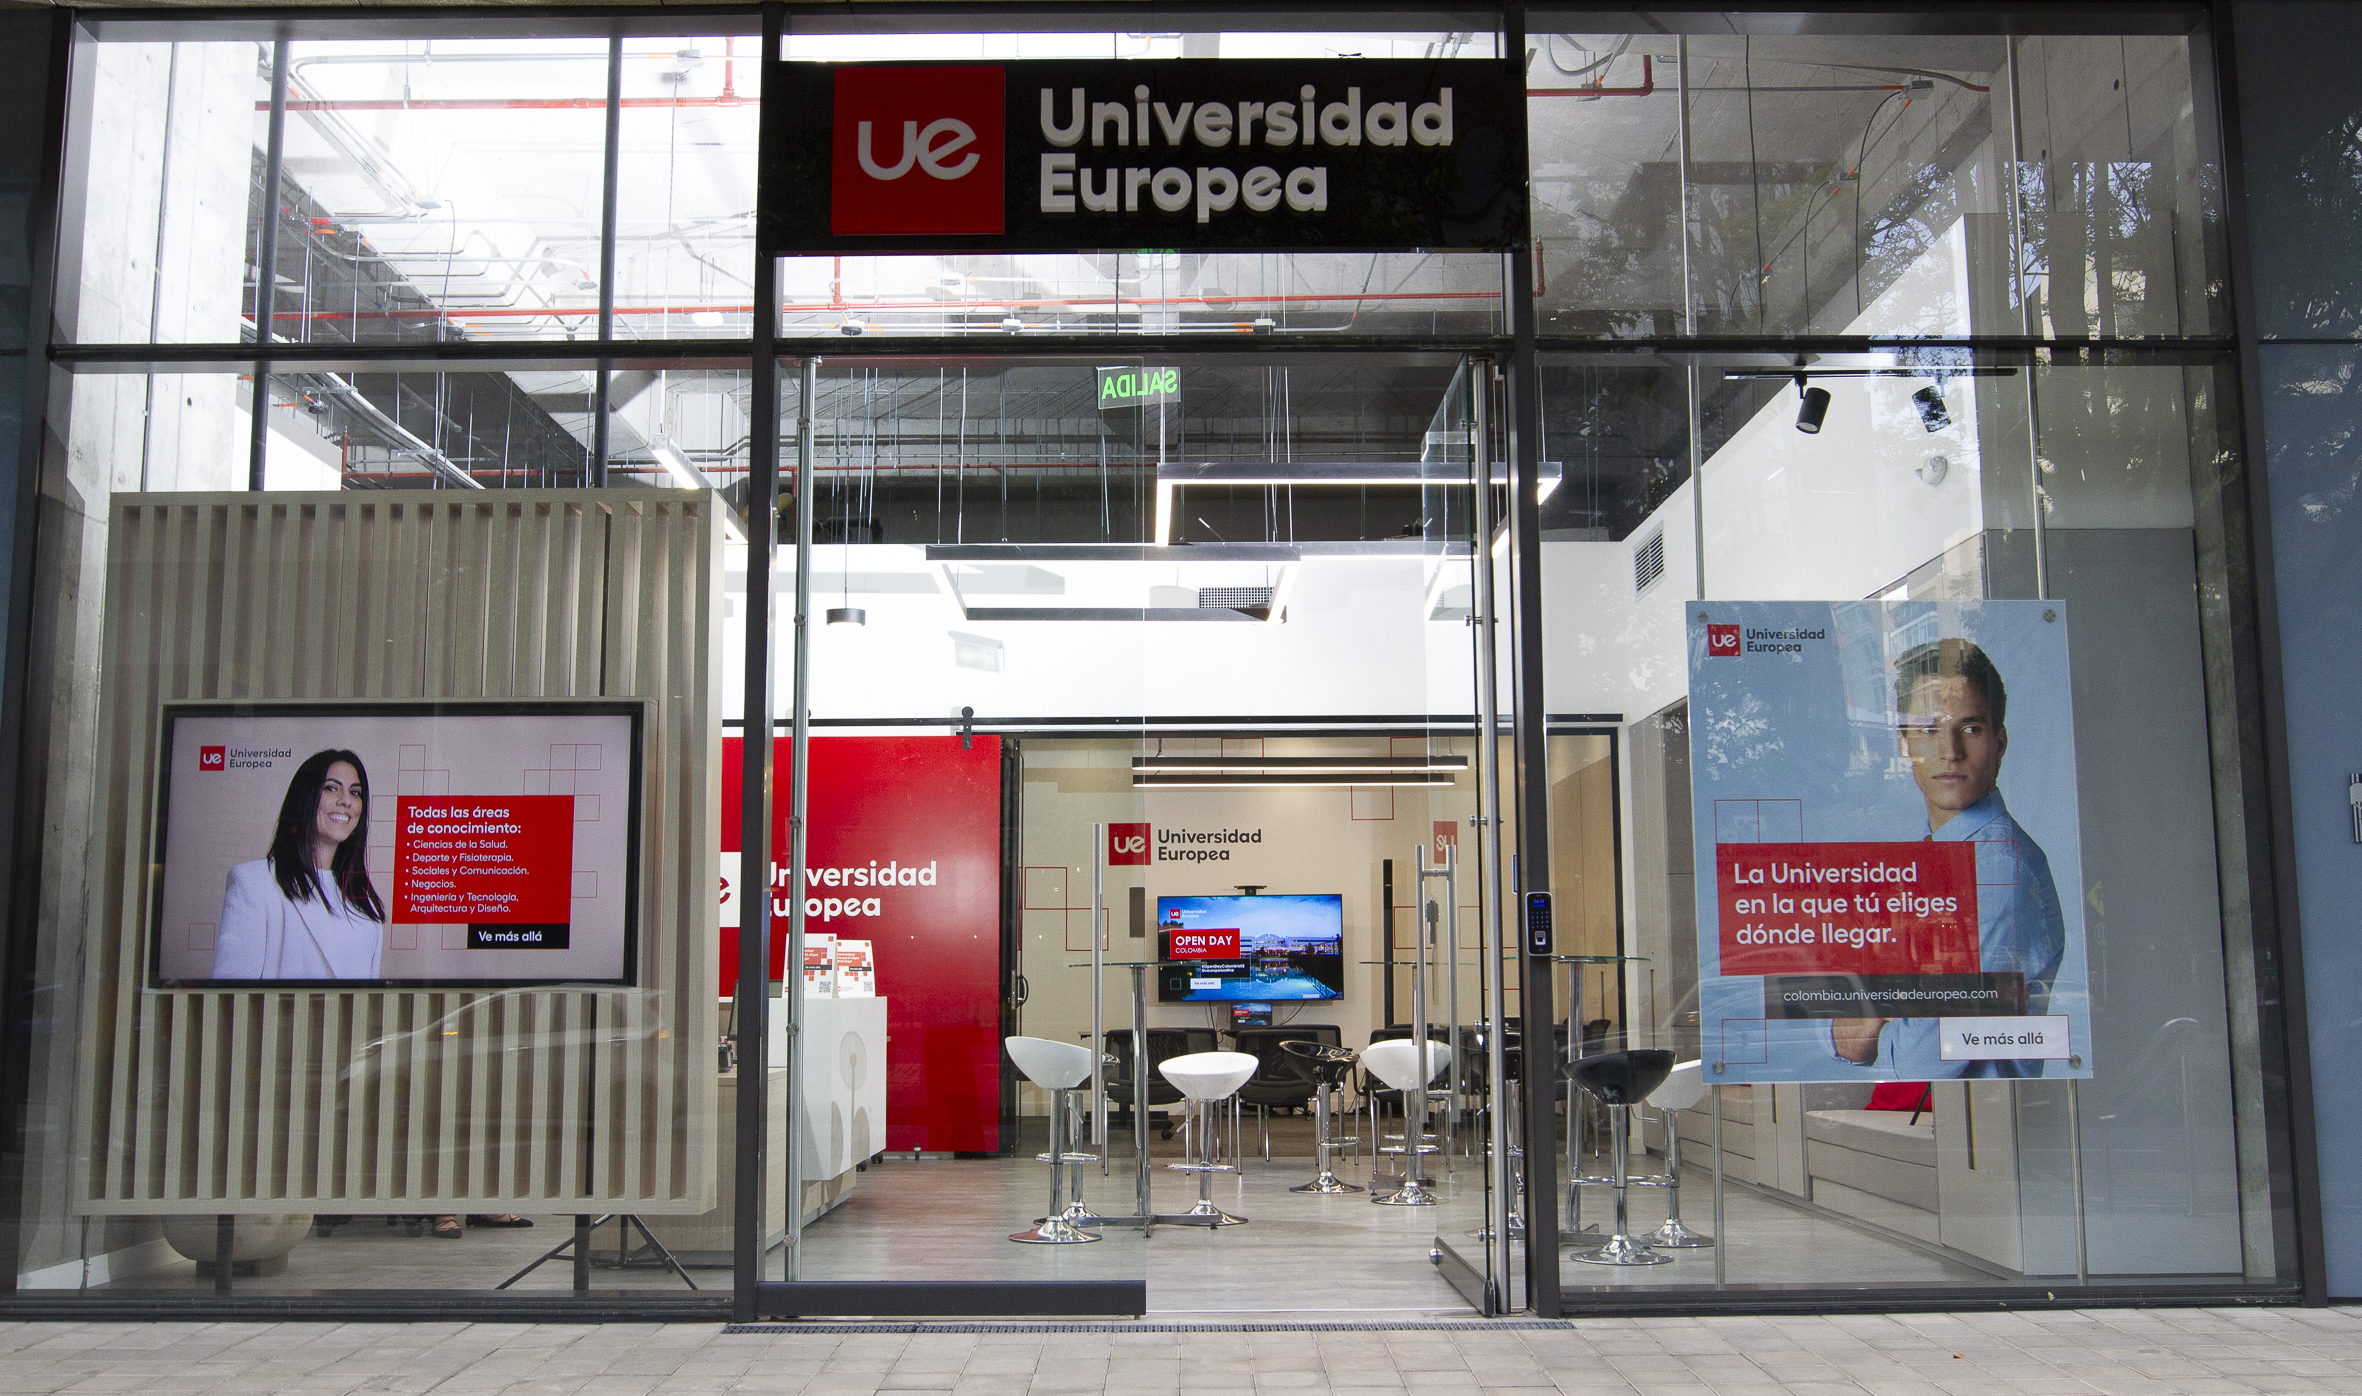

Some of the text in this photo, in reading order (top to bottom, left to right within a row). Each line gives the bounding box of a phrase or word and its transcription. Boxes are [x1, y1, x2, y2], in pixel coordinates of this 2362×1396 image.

[1041, 84, 1453, 147] Universidad
[858, 118, 980, 180] ue
[1041, 153, 1327, 222] Europea
[1712, 634, 1736, 647] ue
[1746, 629, 1825, 640] Universidad
[1747, 641, 1801, 654] Europea
[203, 753, 221, 764] ue
[230, 748, 291, 758] Universidad
[230, 759, 272, 769] Europea
[408, 806, 509, 818] Todas las áreas
[407, 822, 521, 833] de conocimiento:
[1158, 829, 1262, 843] Universidad
[413, 840, 507, 848] Ciencias de la Salud.
[1114, 836, 1146, 853] ue
[412, 853, 514, 863] Deporte y Fisioterapia.
[1158, 846, 1229, 863] Europea
[412, 866, 529, 876] Sociales y Comunicación.
[771, 860, 936, 887] nversidad
[1734, 862, 1917, 884] La Universidad
[411, 880, 456, 890] Negocios.
[410, 893, 456, 903] Ingeniería
[467, 892, 518, 903] Tecnología,
[410, 903, 511, 914] Arquitectura y Diseño.
[770, 892, 881, 922] uopea
[1736, 891, 1958, 918] en la que tú eliges
[478, 931, 542, 941] Ve más allá
[1175, 936, 1232, 946] OPEN DAY
[1736, 923, 1897, 948] dónde llegar.
[1783, 989, 1998, 1001] colombia.universidadeuropea.com
[1962, 1032, 2044, 1045] Ve más allá
